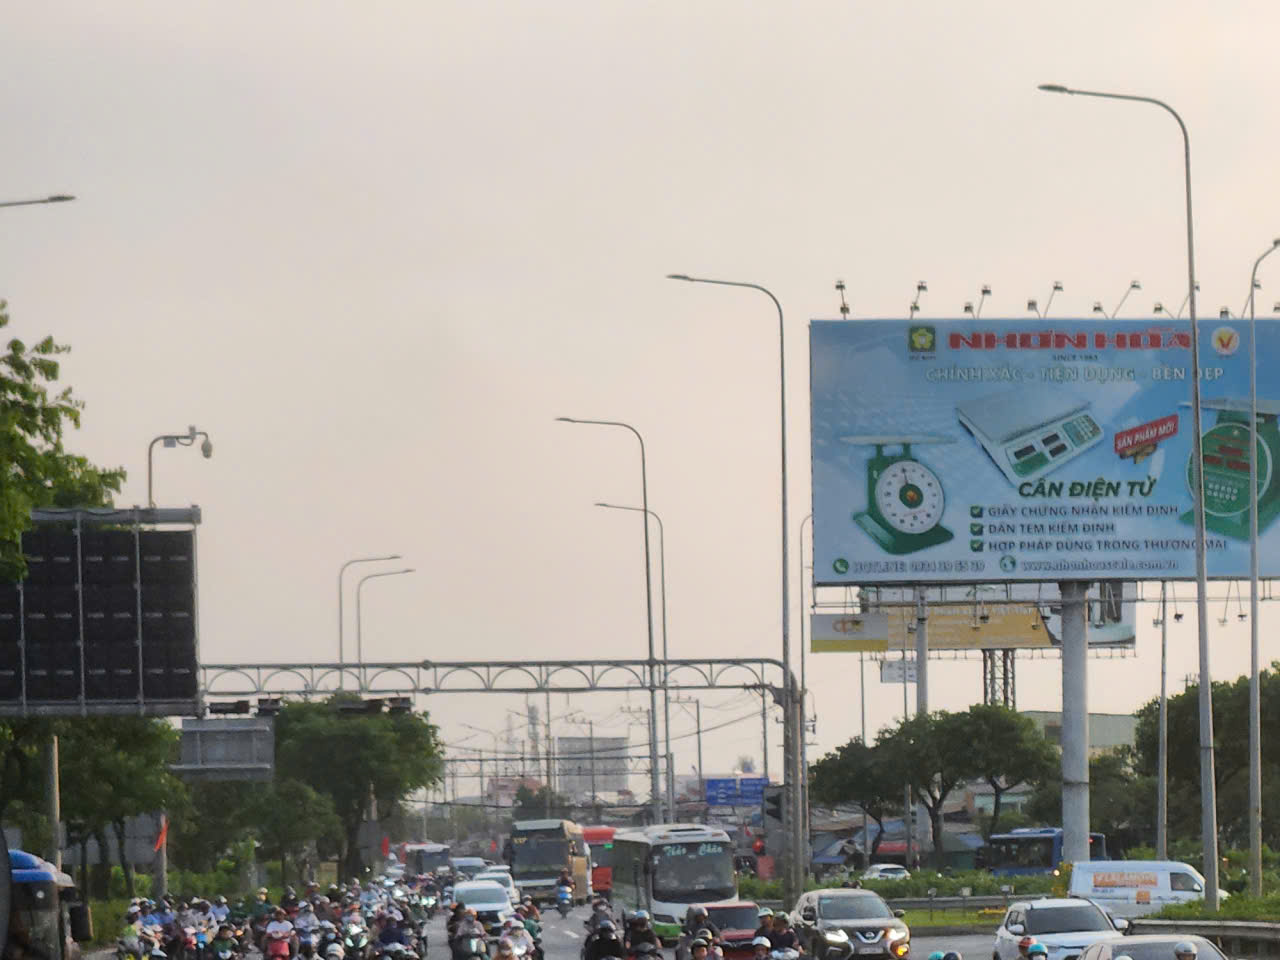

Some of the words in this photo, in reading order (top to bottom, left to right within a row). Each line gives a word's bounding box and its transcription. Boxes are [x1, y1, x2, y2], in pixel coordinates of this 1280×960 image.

[1018, 477, 1064, 498] CÂN
[1068, 477, 1121, 502] ĐIỆN
[1127, 475, 1157, 497] TỬ
[1020, 523, 1044, 534] TEM
[1097, 540, 1140, 551] TRONG
